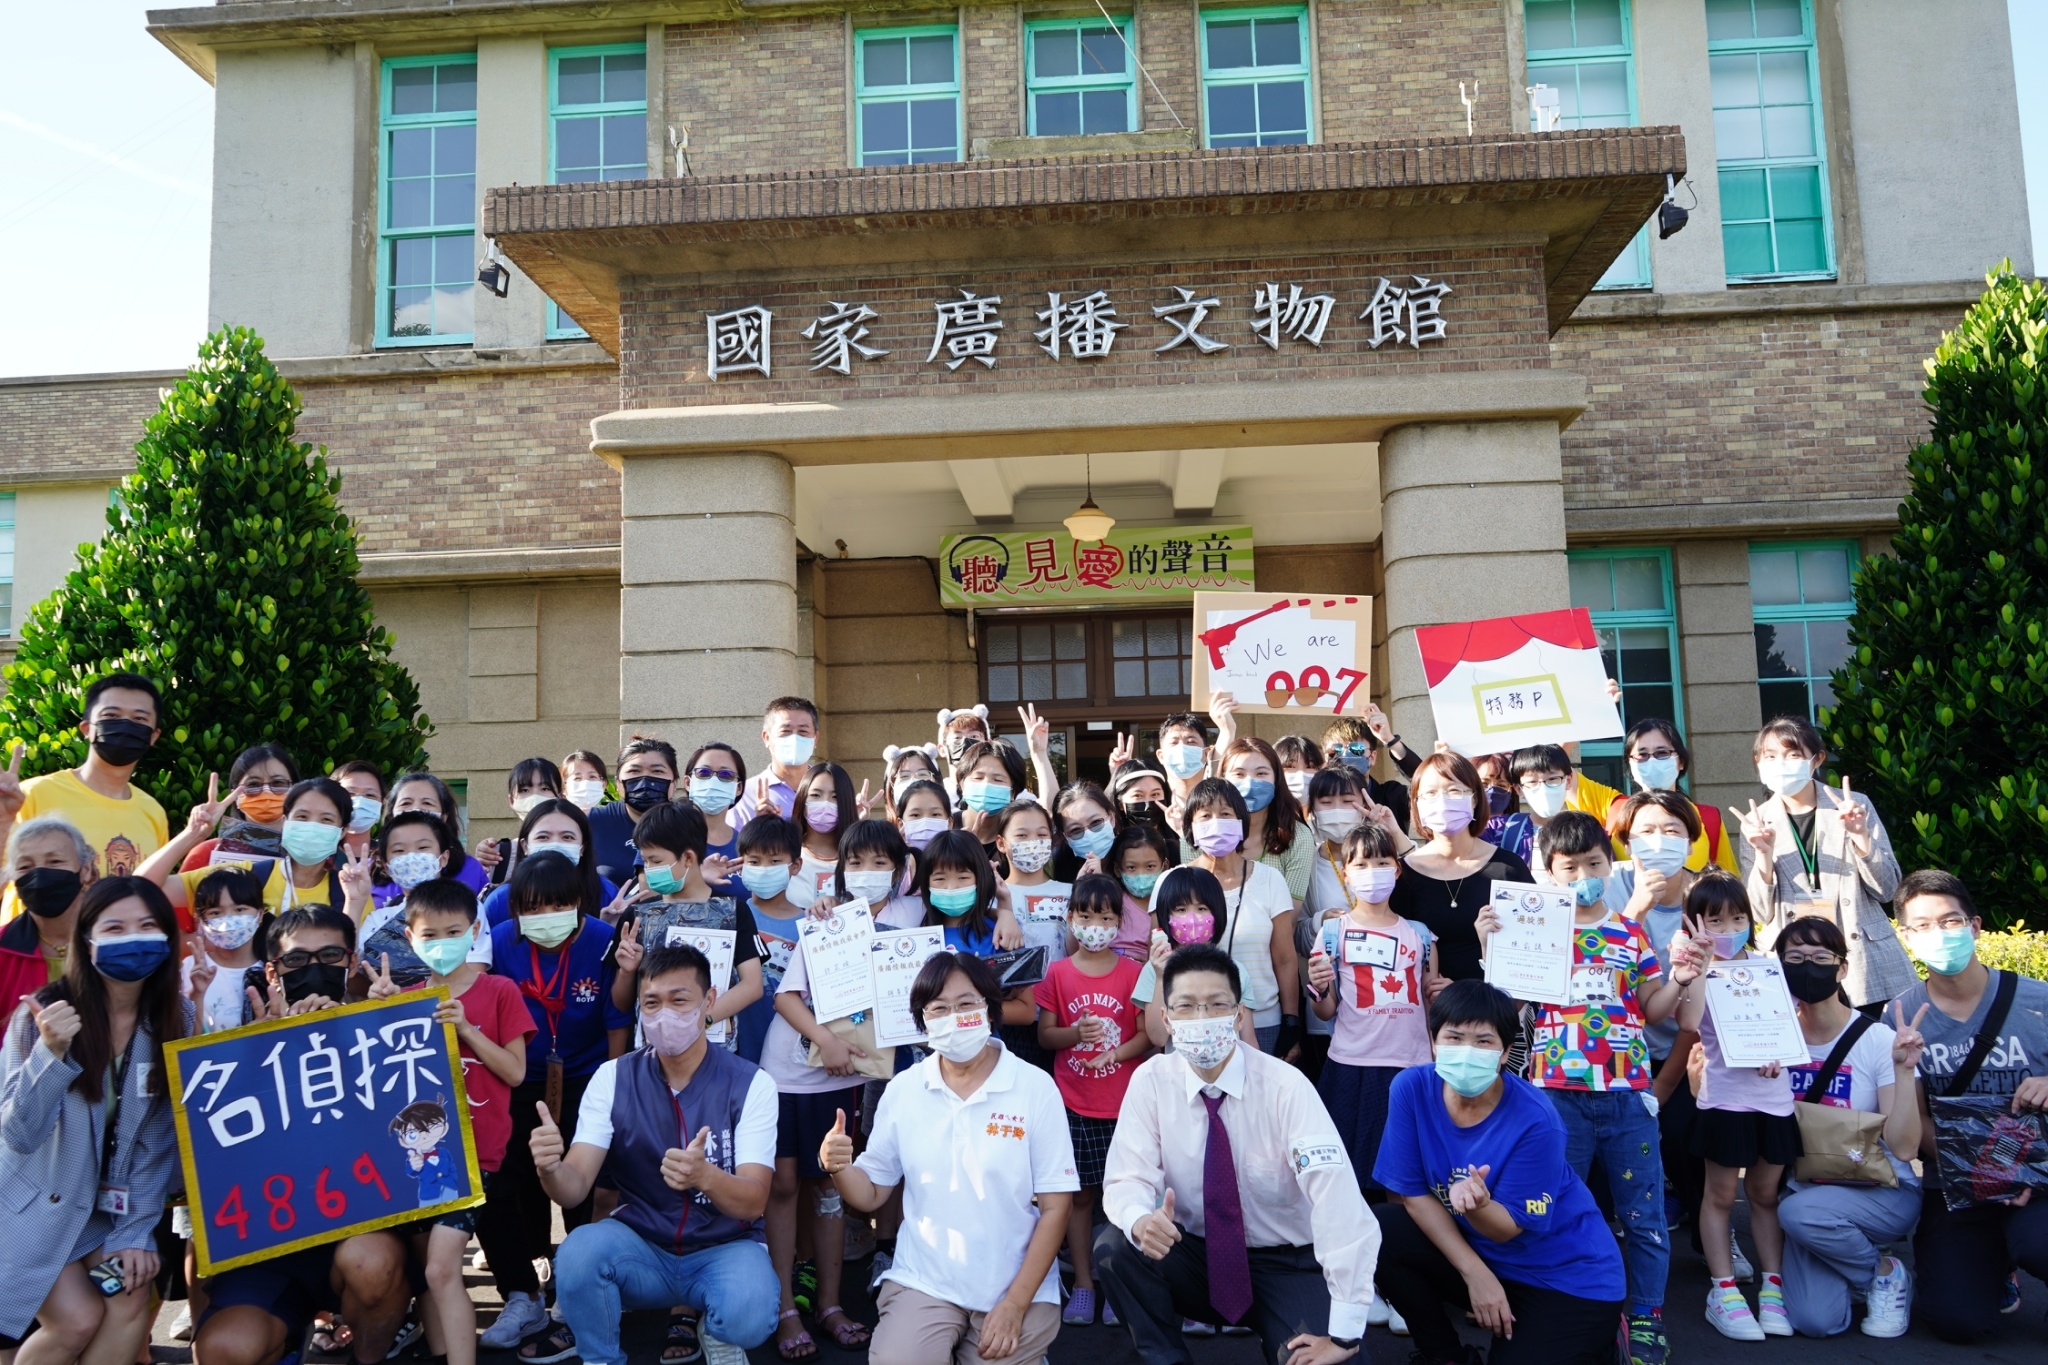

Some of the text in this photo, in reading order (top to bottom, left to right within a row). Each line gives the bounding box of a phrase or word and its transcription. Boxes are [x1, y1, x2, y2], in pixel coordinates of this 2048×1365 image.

[706, 274, 1453, 382] 國家廣播文物館
[961, 533, 1233, 594] 聽見愛的聲音
[1243, 635, 1340, 666] We are
[1264, 665, 1369, 715] 007
[1588, 966, 1614, 982] 007
[1068, 992, 1124, 1014] OLD NAVY
[1919, 1042, 1954, 1074] CR
[1948, 1043, 1970, 1058] 1846
[181, 1017, 443, 1148] 名偵探
[1789, 1071, 1846, 1094] CAIF
[213, 1151, 391, 1240] 4869
